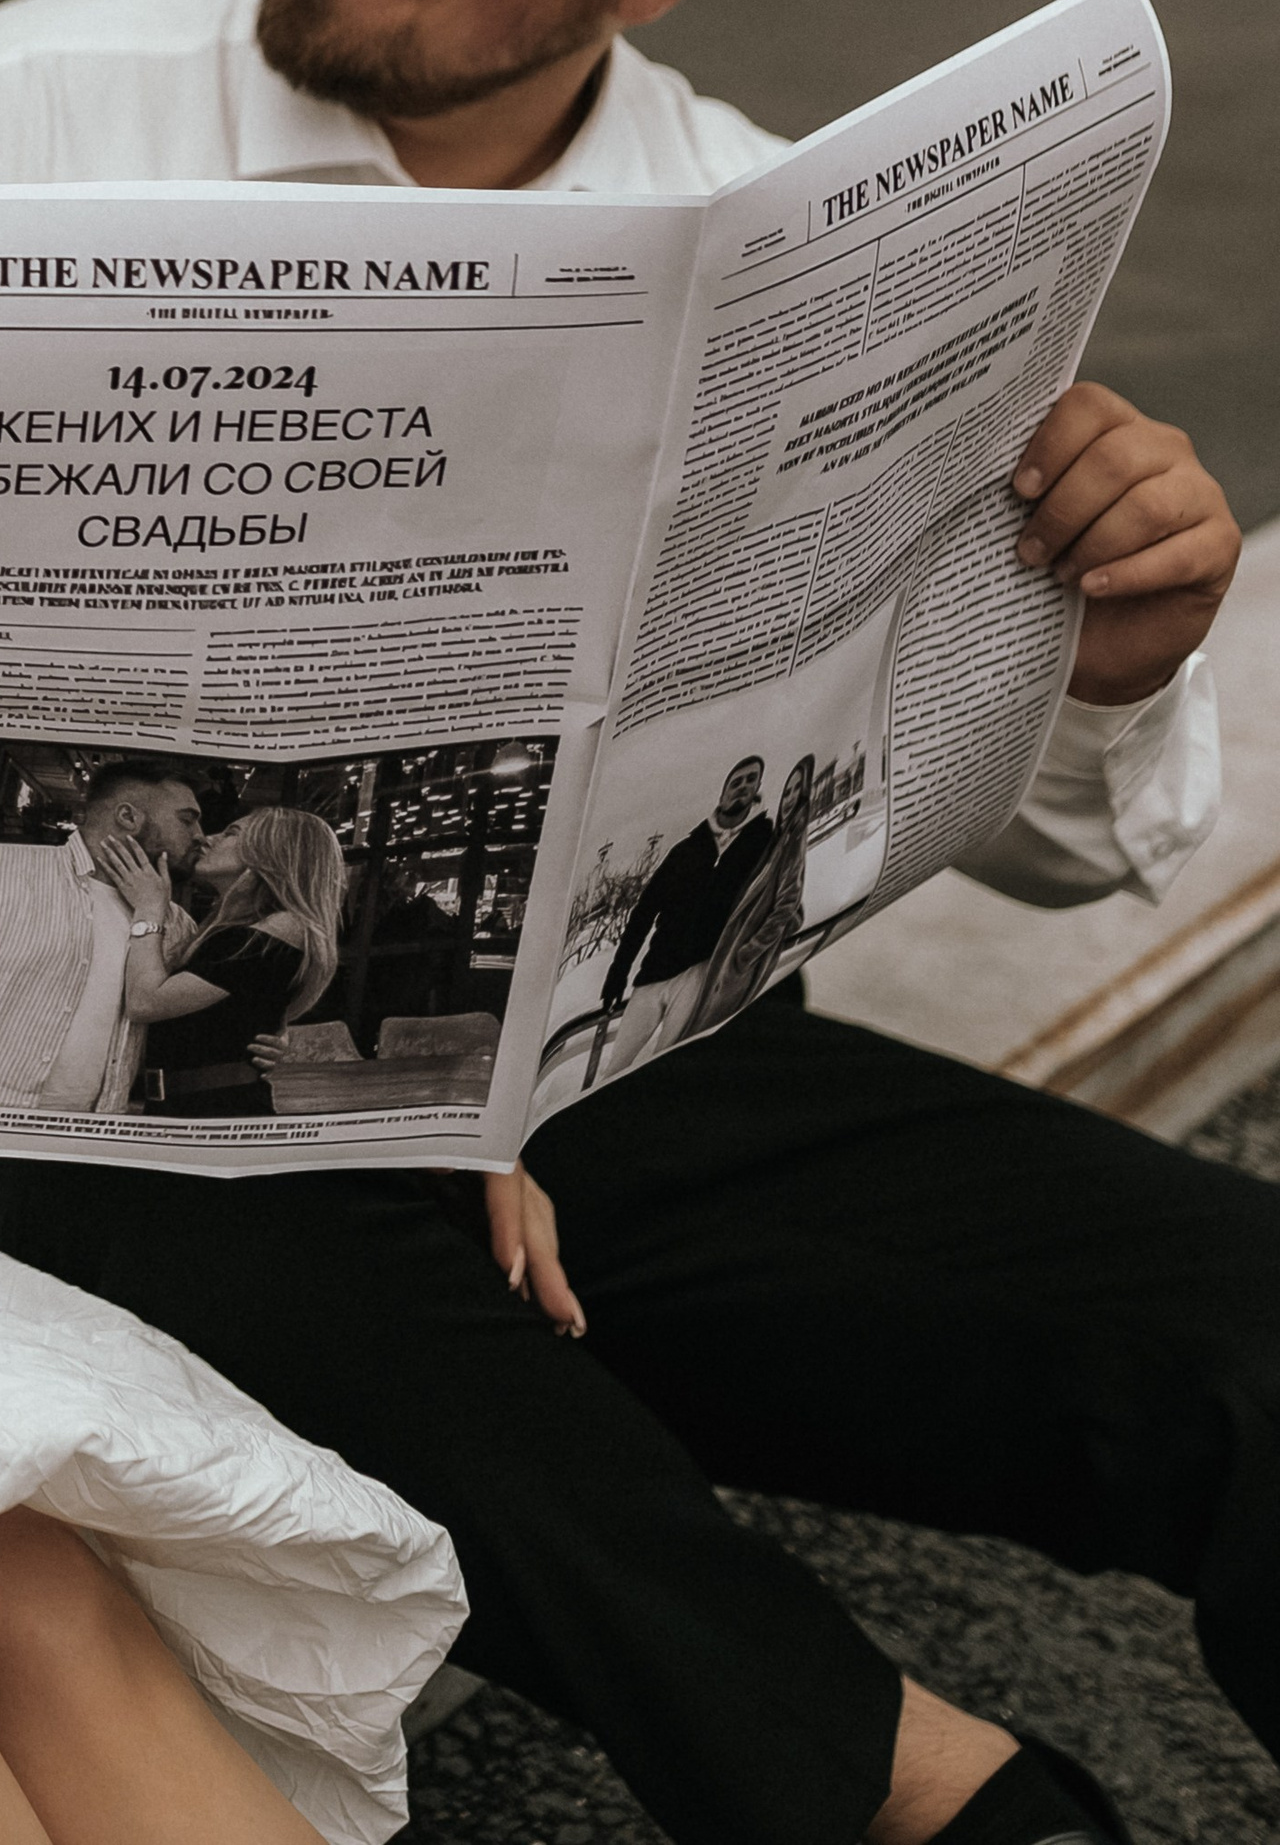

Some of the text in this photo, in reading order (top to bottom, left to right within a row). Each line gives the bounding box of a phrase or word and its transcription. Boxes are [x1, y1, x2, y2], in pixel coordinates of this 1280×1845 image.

[822, 73, 1074, 227] THE NEWSPAPER NAME
[91, 257, 352, 290] NEWSPAPER
[364, 260, 491, 291] NAME
[107, 365, 319, 399] 14.07.2024
[168, 410, 201, 443] И
[213, 406, 433, 443] НЕВЕСТА
[203, 462, 273, 496] СО
[284, 449, 448, 494] СВОЕЙ
[77, 511, 308, 554] СВАДЬБЫ
